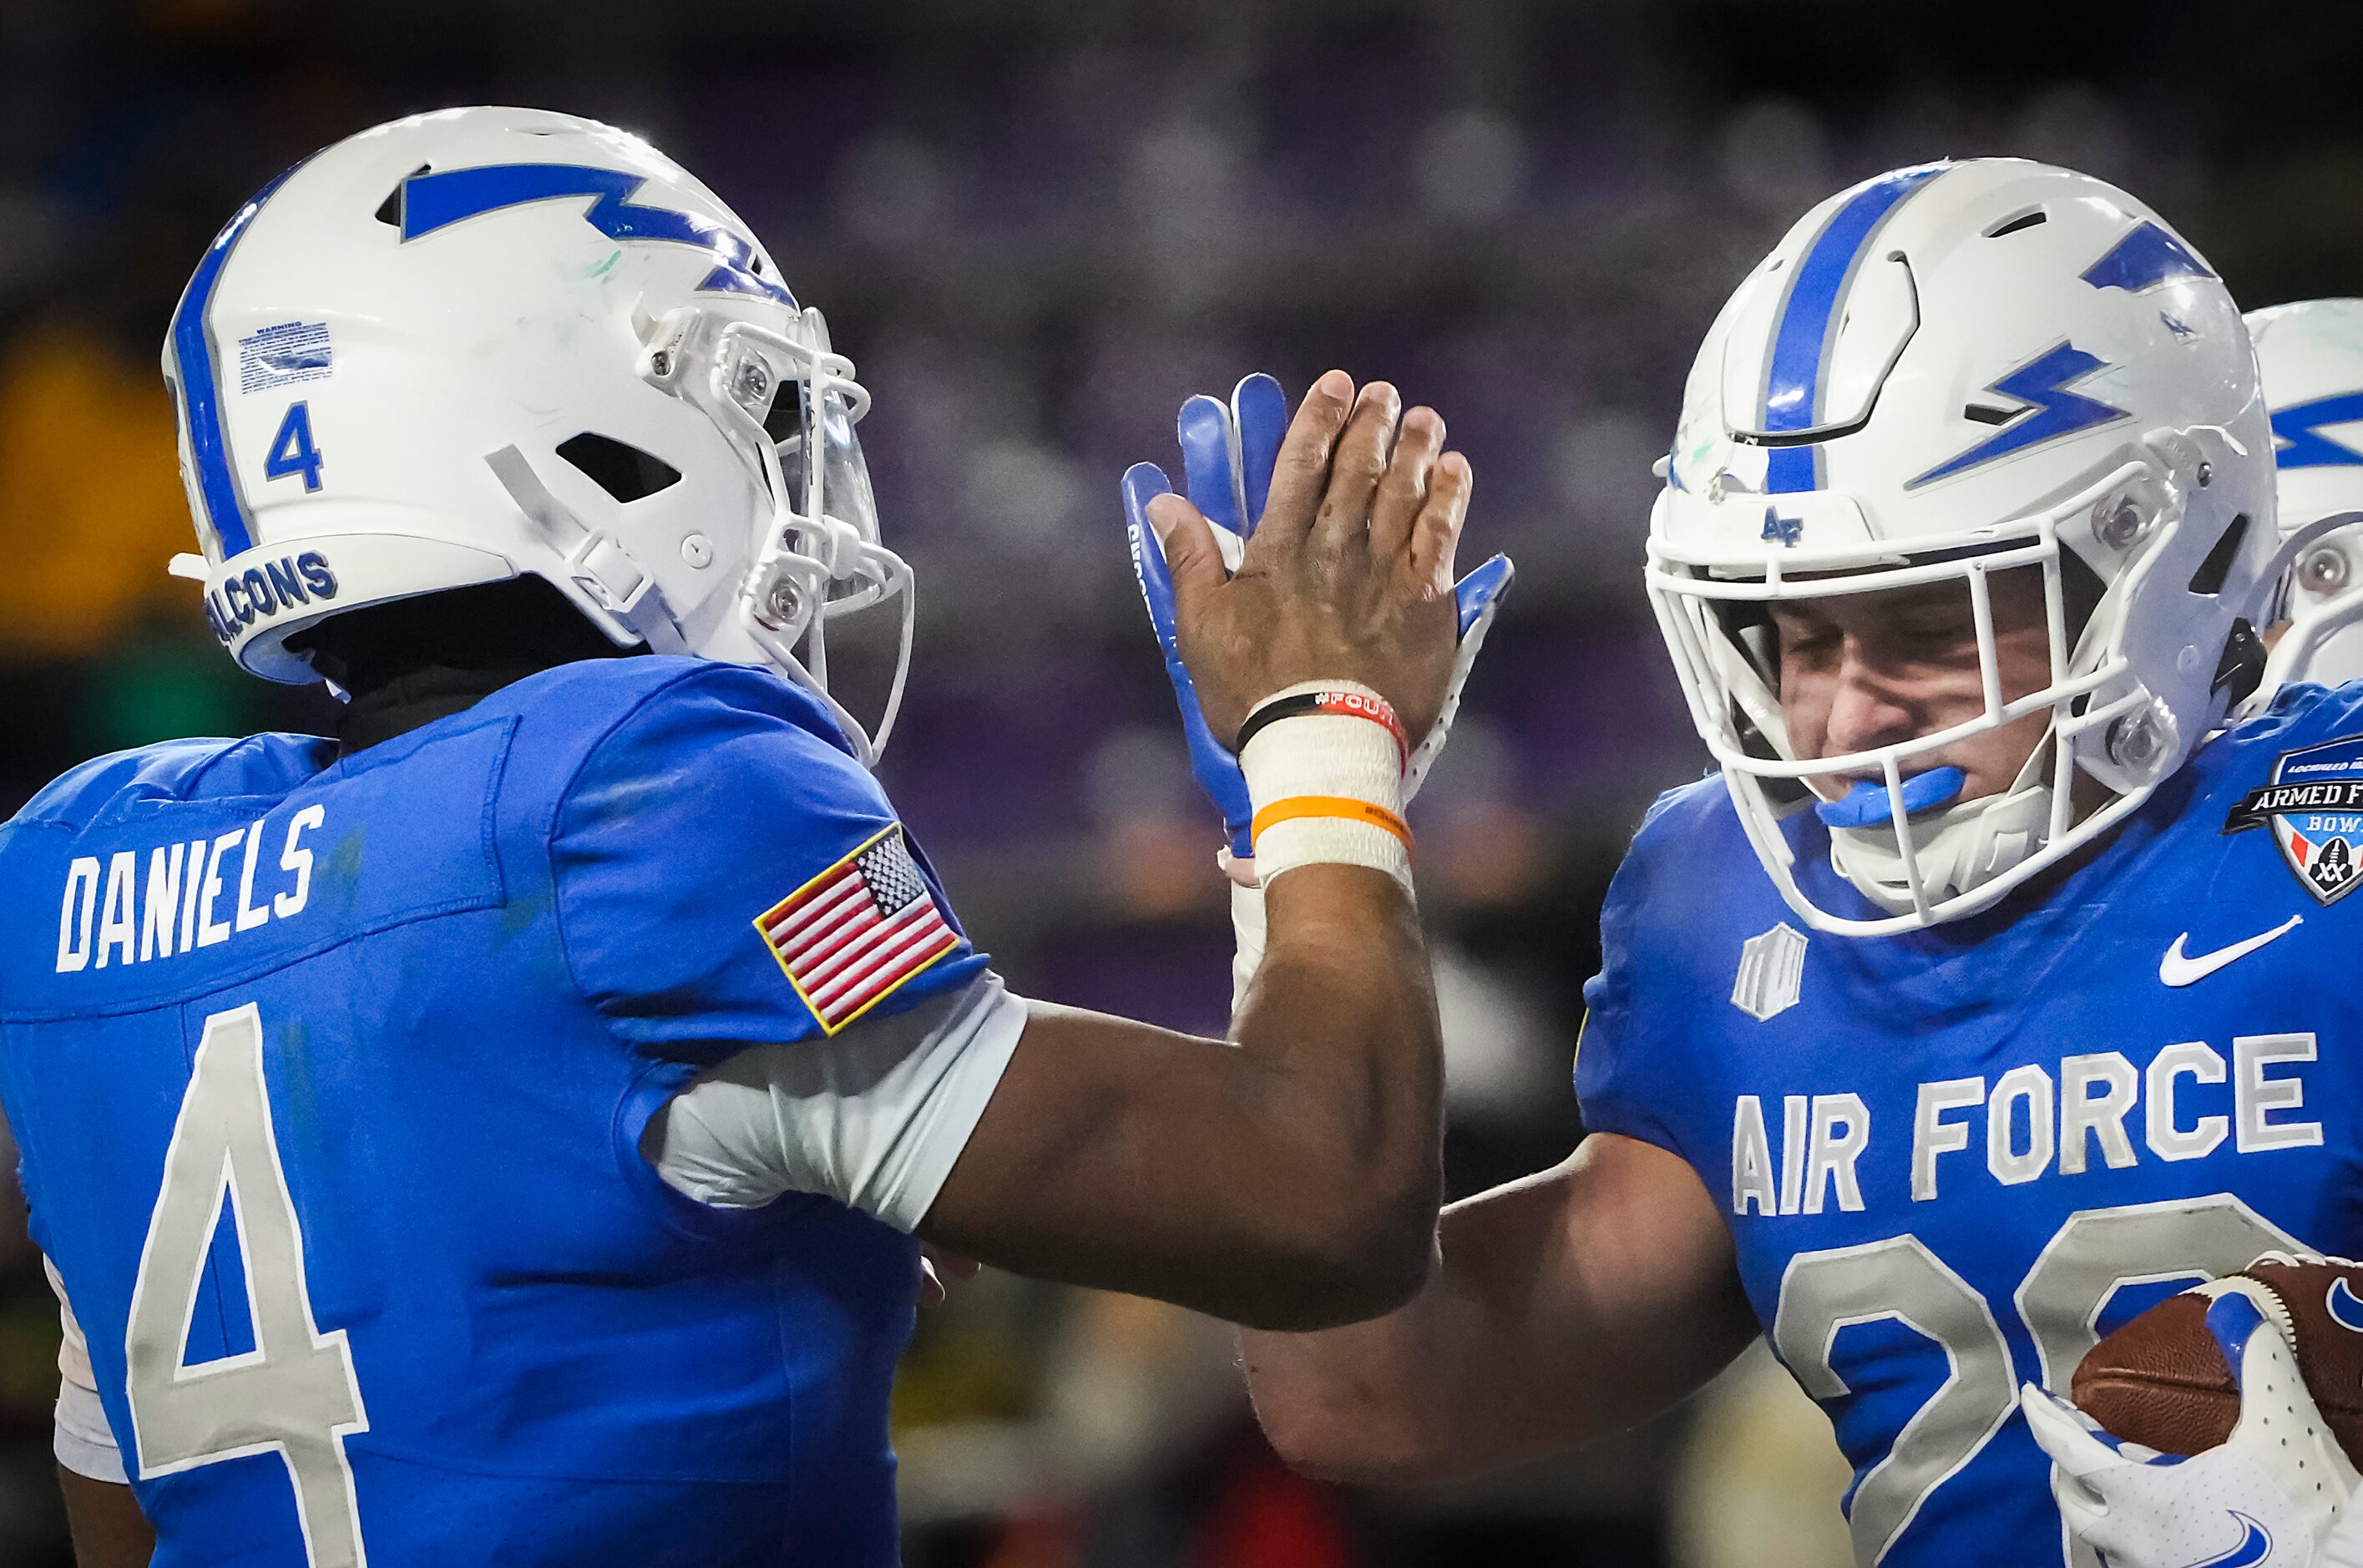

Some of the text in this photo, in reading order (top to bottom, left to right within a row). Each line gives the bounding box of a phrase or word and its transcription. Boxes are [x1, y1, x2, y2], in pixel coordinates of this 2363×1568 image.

[256, 321, 302, 334] WARNING
[264, 400, 325, 493] 4
[2251, 785, 2343, 812] ARMED
[55, 803, 326, 974] DANIELS
[1733, 1032, 2325, 1216] AIR FORCE
[125, 1002, 370, 1568] 4
